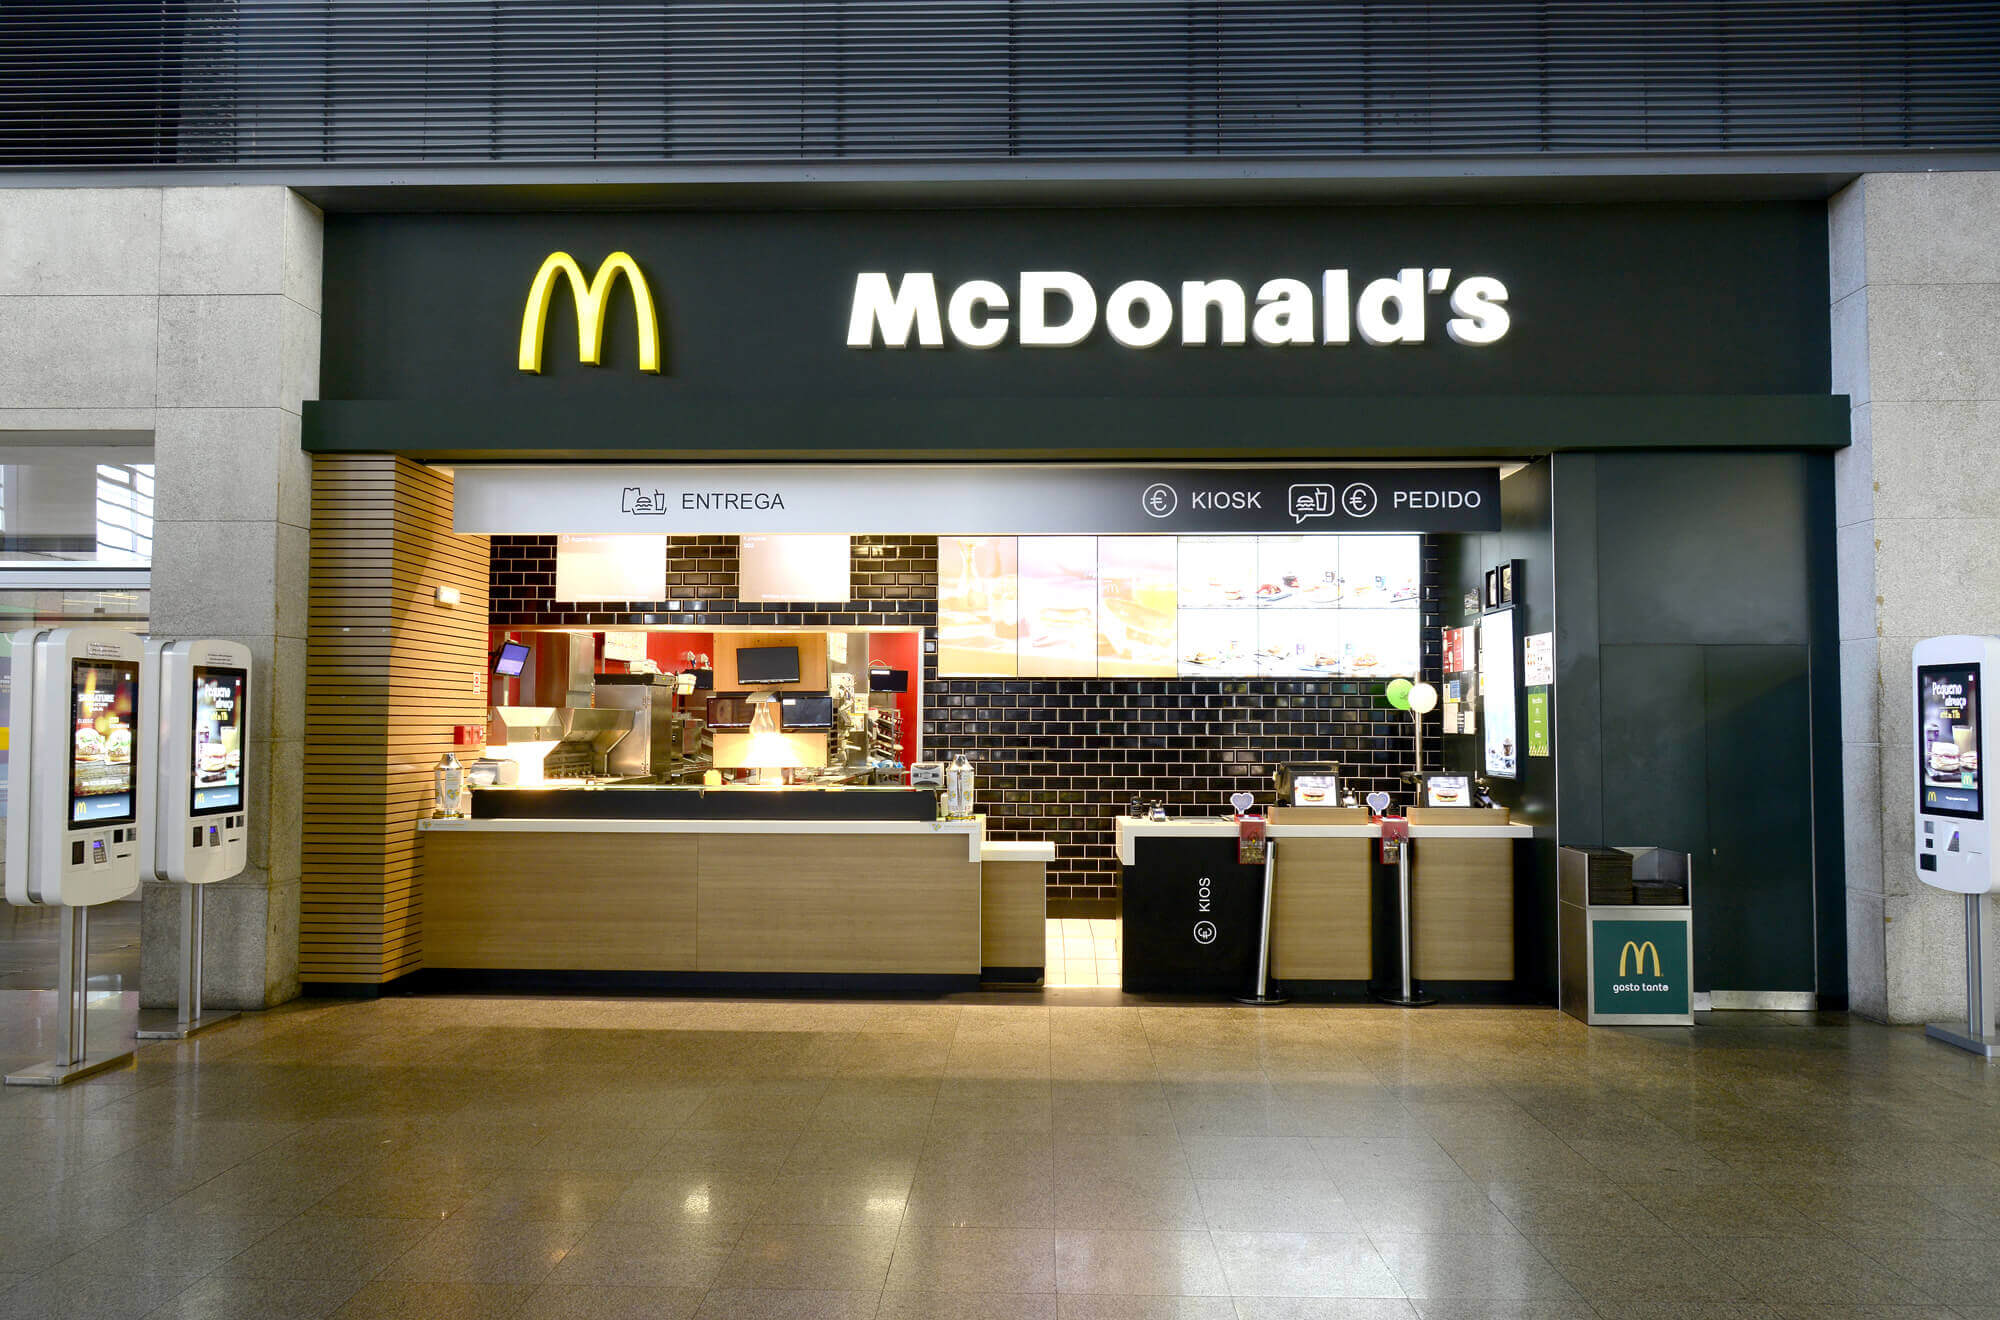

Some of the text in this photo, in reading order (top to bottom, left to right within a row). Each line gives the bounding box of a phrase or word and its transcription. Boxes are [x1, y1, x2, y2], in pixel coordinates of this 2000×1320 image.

[845, 267, 1512, 348] McDonald's
[681, 492, 786, 511] ENTREGA
[1191, 490, 1263, 510] KIOSK
[1392, 490, 1482, 509] PEDIDO
[1198, 877, 1211, 912] KIOS
[1612, 983, 1640, 994] gosto
